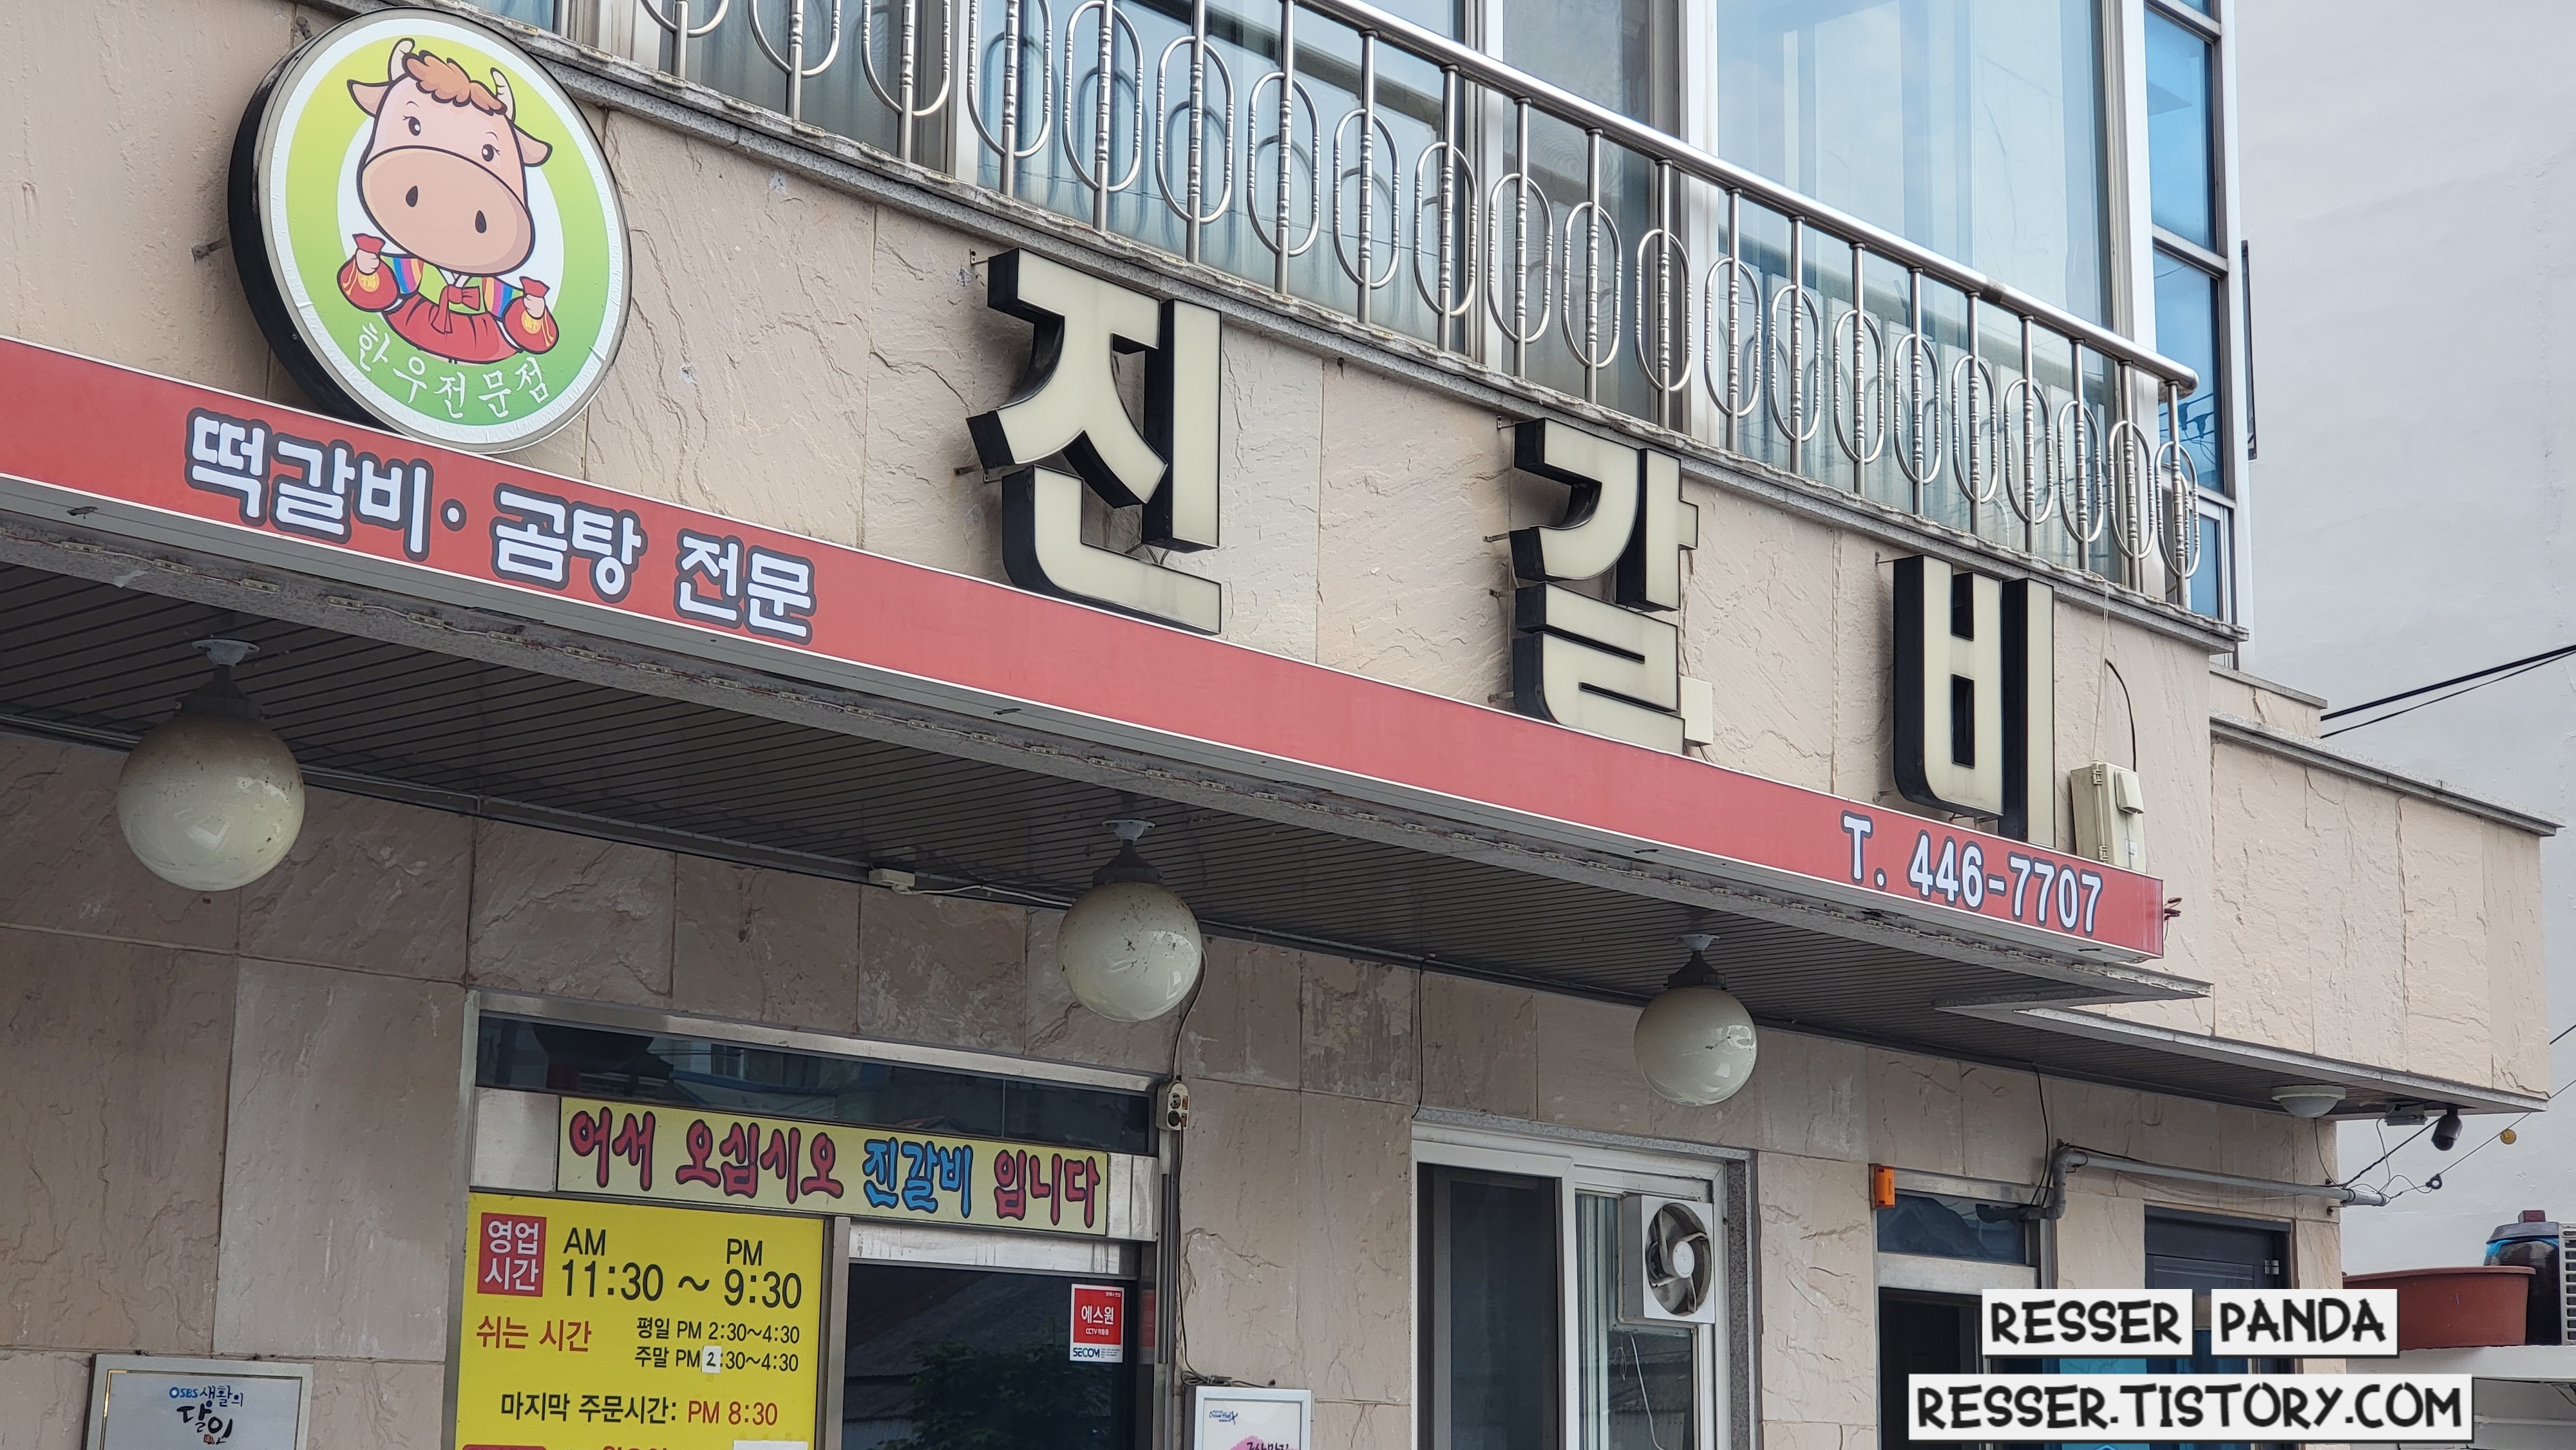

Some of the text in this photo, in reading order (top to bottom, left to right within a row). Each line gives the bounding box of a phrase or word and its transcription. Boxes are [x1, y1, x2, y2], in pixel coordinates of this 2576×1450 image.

[359, 322, 549, 418] 한우전문점
[493, 482, 645, 603] 곰탕
[675, 529, 816, 644] 전문
[1841, 809, 2103, 936] T. 446-7707
[569, 1107, 1101, 1229] 어서 오십시오 진갈비 입니다
[488, 1220, 539, 1255] 영업
[563, 1227, 763, 1266] AM PM
[484, 1257, 539, 1292] 시간
[562, 1259, 664, 1301] 11:30
[724, 1268, 802, 1308] 9:30
[636, 1317, 800, 1344] 평일 PM 2:30~4:30
[1081, 1305, 1114, 1325] 에스원
[476, 1315, 592, 1352] 쉬는 시간
[634, 1346, 670, 1368] 주말
[676, 1350, 701, 1368] PM
[1073, 1347, 1100, 1358] SECOM
[199, 1385, 243, 1408] 생활의
[501, 1392, 778, 1426] 마지막 주문시간: PM 8:30
[176, 1403, 233, 1445] 달인
